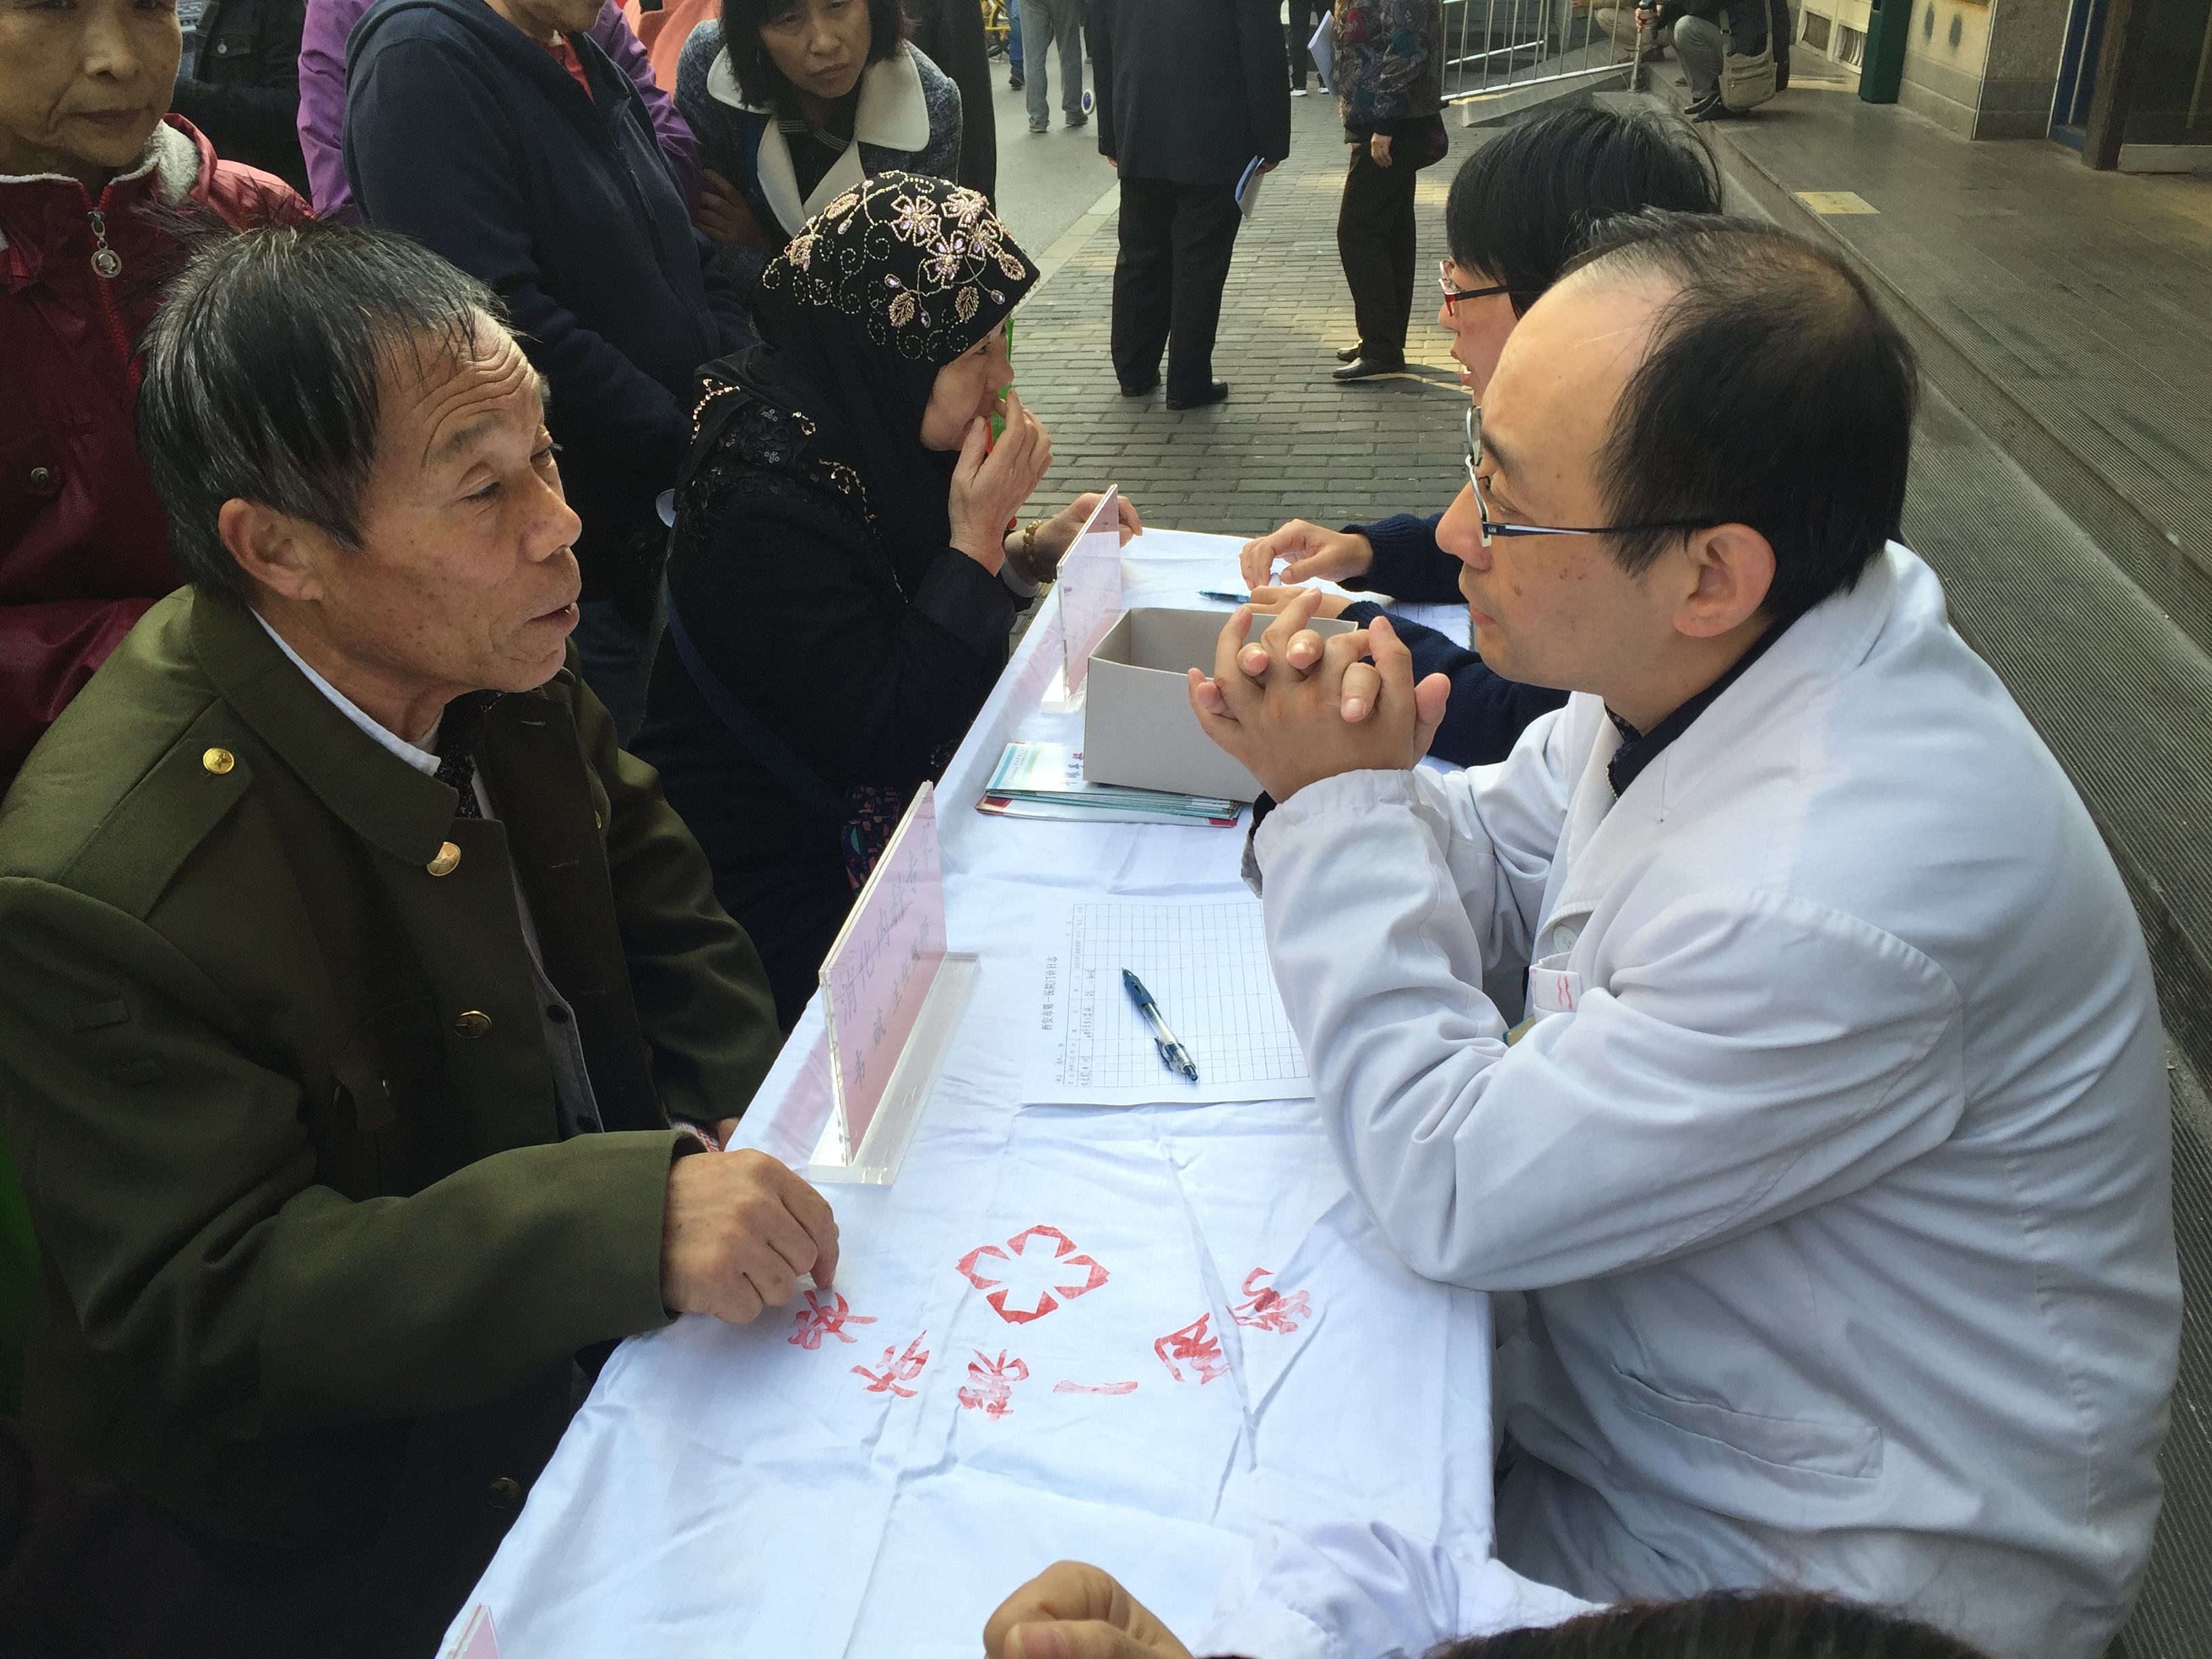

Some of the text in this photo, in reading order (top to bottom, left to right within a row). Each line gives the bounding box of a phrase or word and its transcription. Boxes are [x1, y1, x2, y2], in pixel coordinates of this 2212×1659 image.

[1042, 956, 1057, 1031] 西安市第一医院门诊日志
